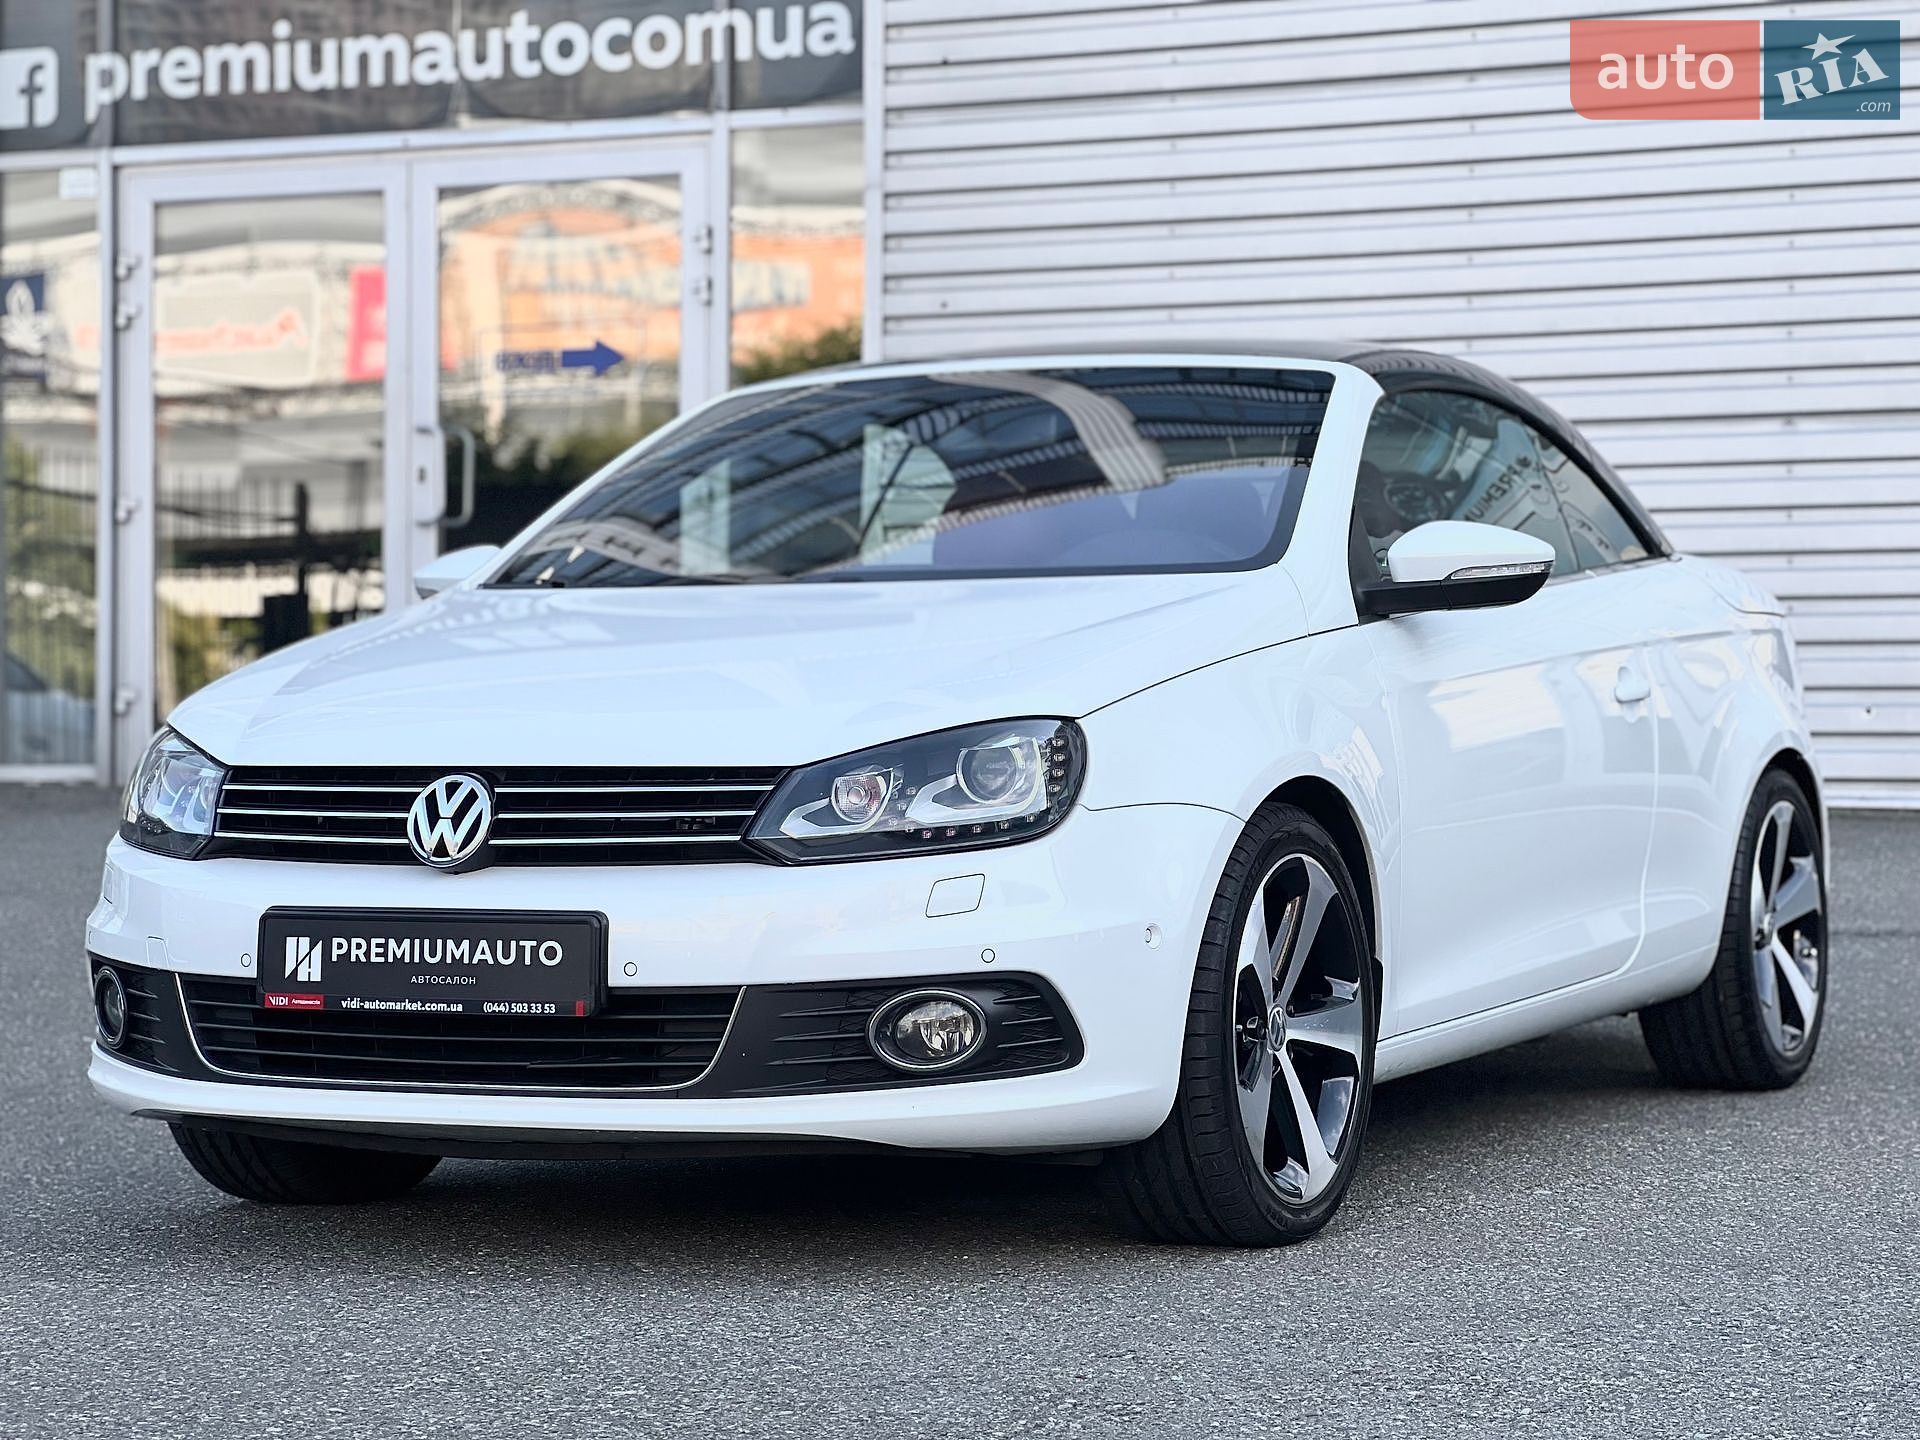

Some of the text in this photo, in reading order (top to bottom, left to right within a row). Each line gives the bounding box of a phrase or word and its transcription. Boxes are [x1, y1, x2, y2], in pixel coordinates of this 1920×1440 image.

[85, 0, 856, 124] premiumautocomua
[331, 936, 563, 966] PREMIUMAUTO
[410, 975, 476, 985] АВТОСАЛОН
[268, 995, 289, 1006] VIDI
[341, 997, 463, 1012] vidi-automarket.com.ua
[483, 1001, 509, 1014] (044)
[511, 1002, 529, 1013] 503
[530, 1003, 542, 1014] 33
[543, 1003, 556, 1014] 53
